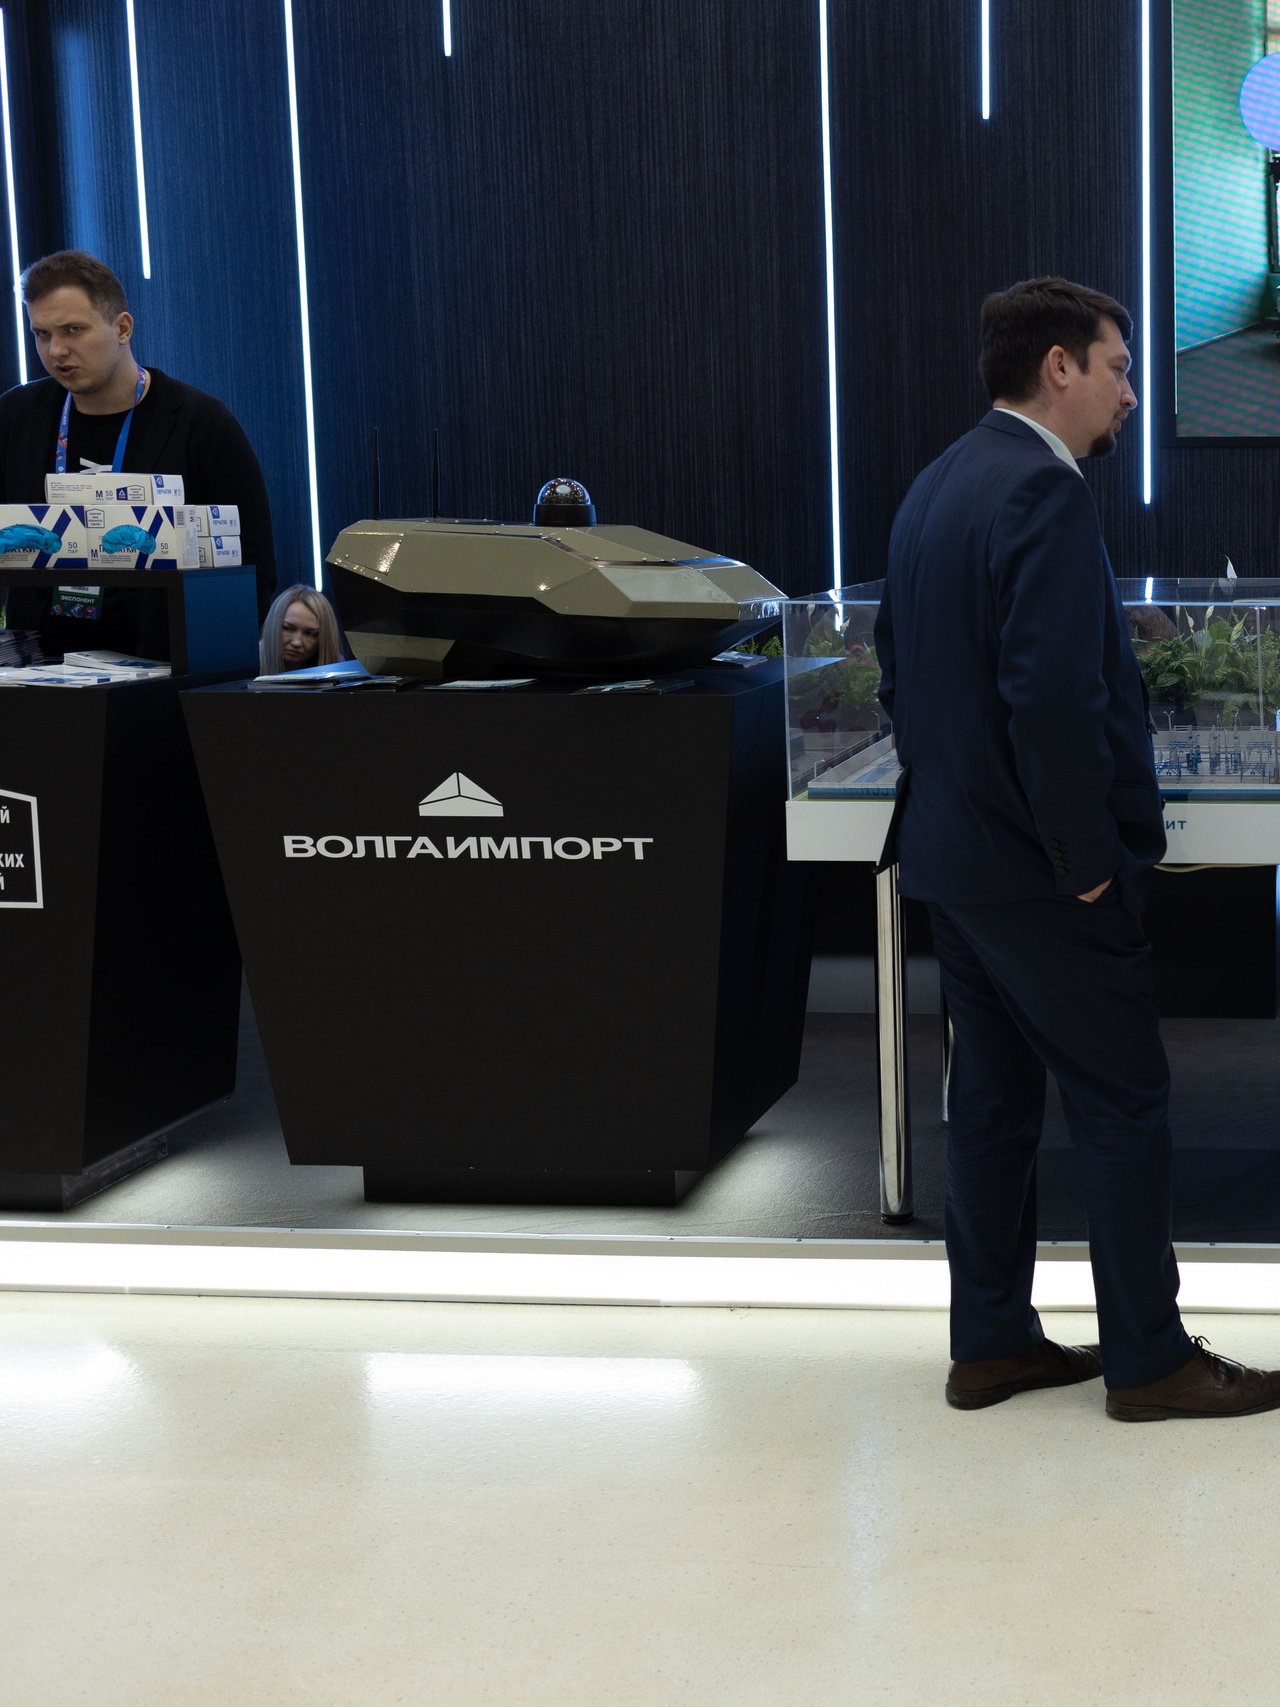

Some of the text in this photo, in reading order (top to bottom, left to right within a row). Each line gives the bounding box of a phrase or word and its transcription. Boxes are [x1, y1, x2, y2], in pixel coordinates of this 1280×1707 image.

[160, 542, 169, 550] 50
[60, 595, 95, 604] ЭКСПОНЕНТ
[283, 835, 654, 860] ВОЛГАИМПОРТ
